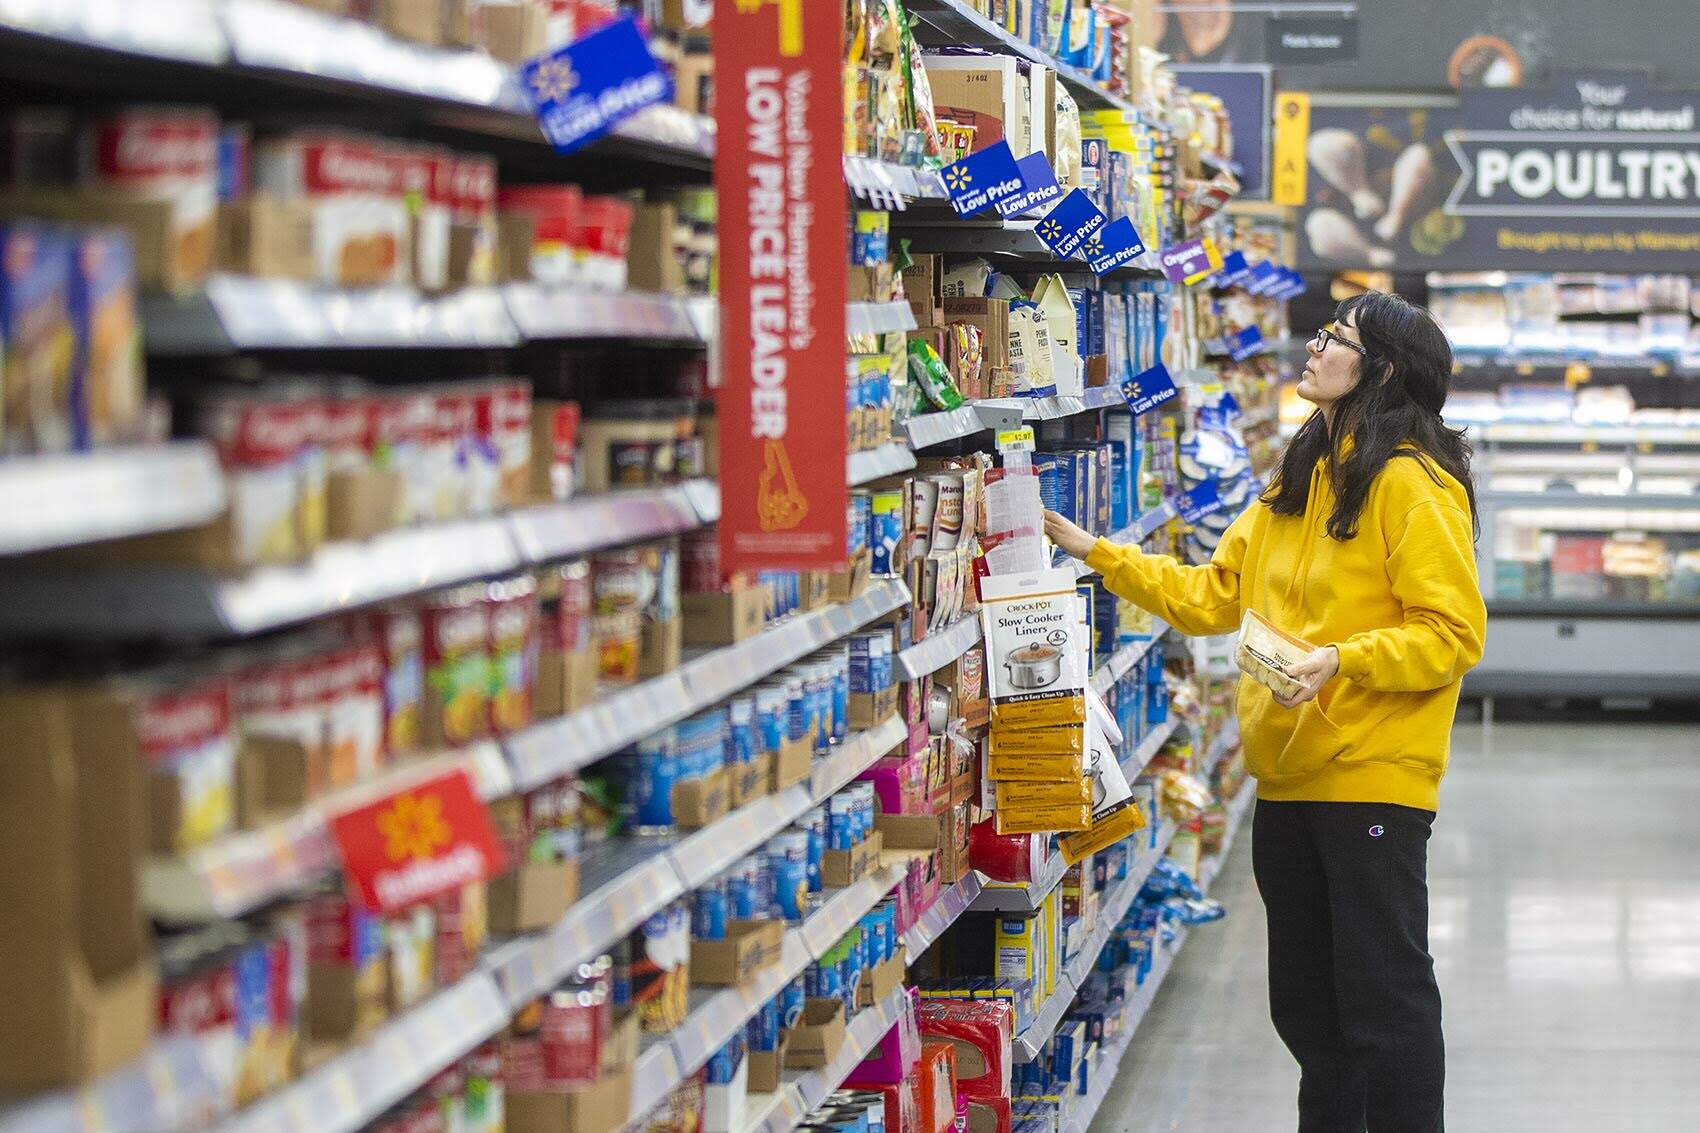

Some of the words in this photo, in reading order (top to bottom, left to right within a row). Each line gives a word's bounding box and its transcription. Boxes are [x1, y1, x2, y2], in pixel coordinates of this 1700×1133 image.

[1575, 80, 1627, 106] Your
[745, 67, 784, 157] LOW
[1509, 105, 1580, 130] choice
[1582, 104, 1614, 130] for
[1616, 105, 1694, 130] natural
[787, 144, 813, 200] New
[957, 194, 987, 214] Low
[986, 178, 1022, 201] Price
[1001, 197, 1028, 215] Low
[1026, 185, 1058, 204] Price
[748, 162, 785, 279] PRICE
[1057, 235, 1080, 257] Low
[1076, 214, 1103, 238] Price
[1093, 257, 1117, 273] Low
[1115, 244, 1142, 262] Price
[788, 202, 815, 350] Hampshire's
[750, 284, 788, 439] LEADER
[1133, 400, 1153, 414] Low
[1151, 388, 1176, 404] Price
[998, 617, 1023, 628] Slow
[1025, 613, 1064, 625] Cooker
[1015, 626, 1048, 636] Liners
[1008, 695, 1024, 703] Quick
[1029, 694, 1041, 702] Easy
